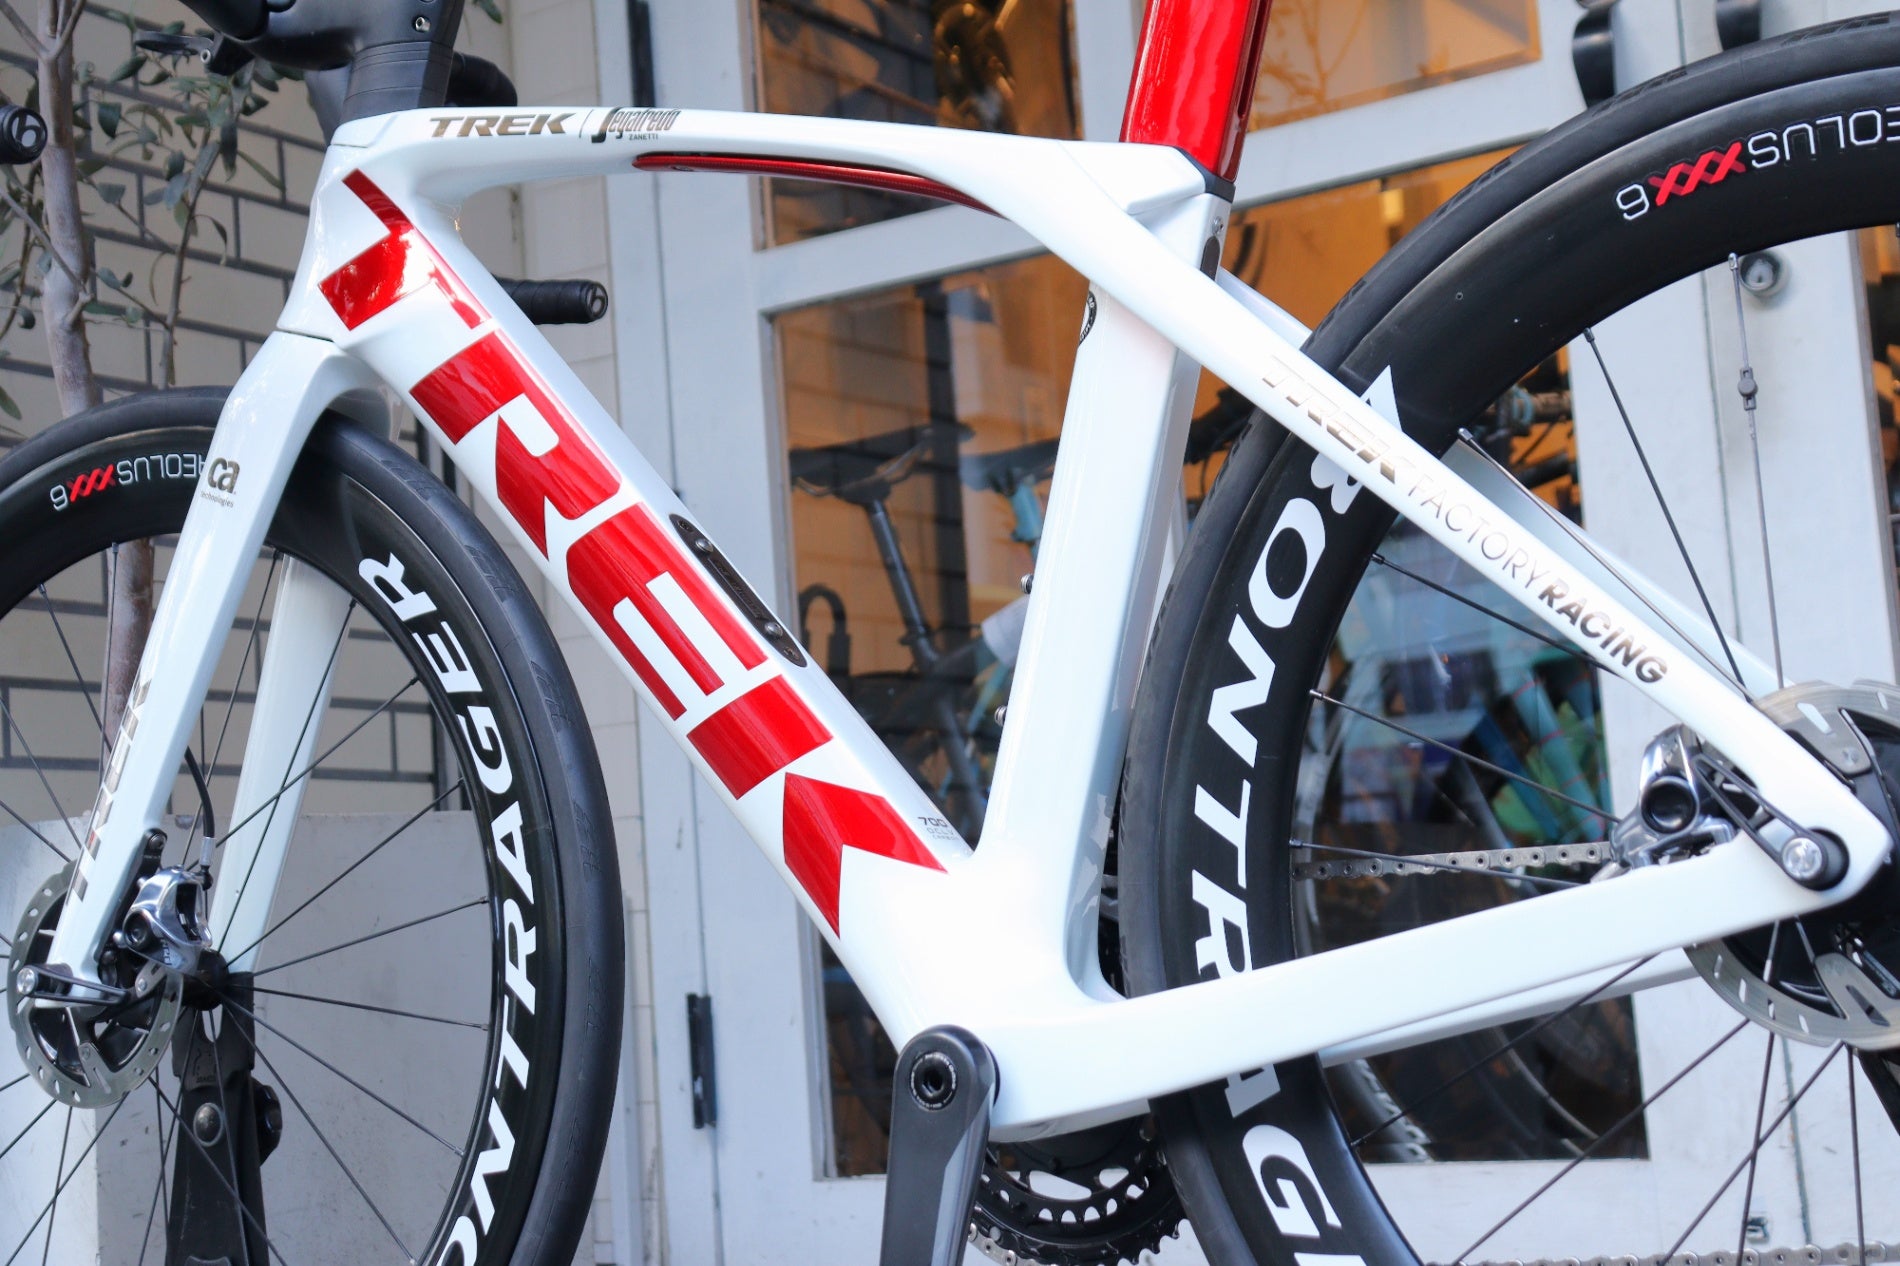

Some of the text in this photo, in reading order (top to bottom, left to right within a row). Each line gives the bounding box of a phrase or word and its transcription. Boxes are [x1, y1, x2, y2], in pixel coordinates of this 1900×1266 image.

[430, 106, 682, 144] TREK Segafredo
[628, 133, 659, 141] ZANETTI
[1616, 184, 1650, 220] 6
[207, 457, 240, 494] ca
[50, 485, 69, 512] 6
[1262, 354, 1668, 684] TREK FACTORY RACING
[319, 168, 947, 938] TREK
[917, 816, 948, 828] 700
